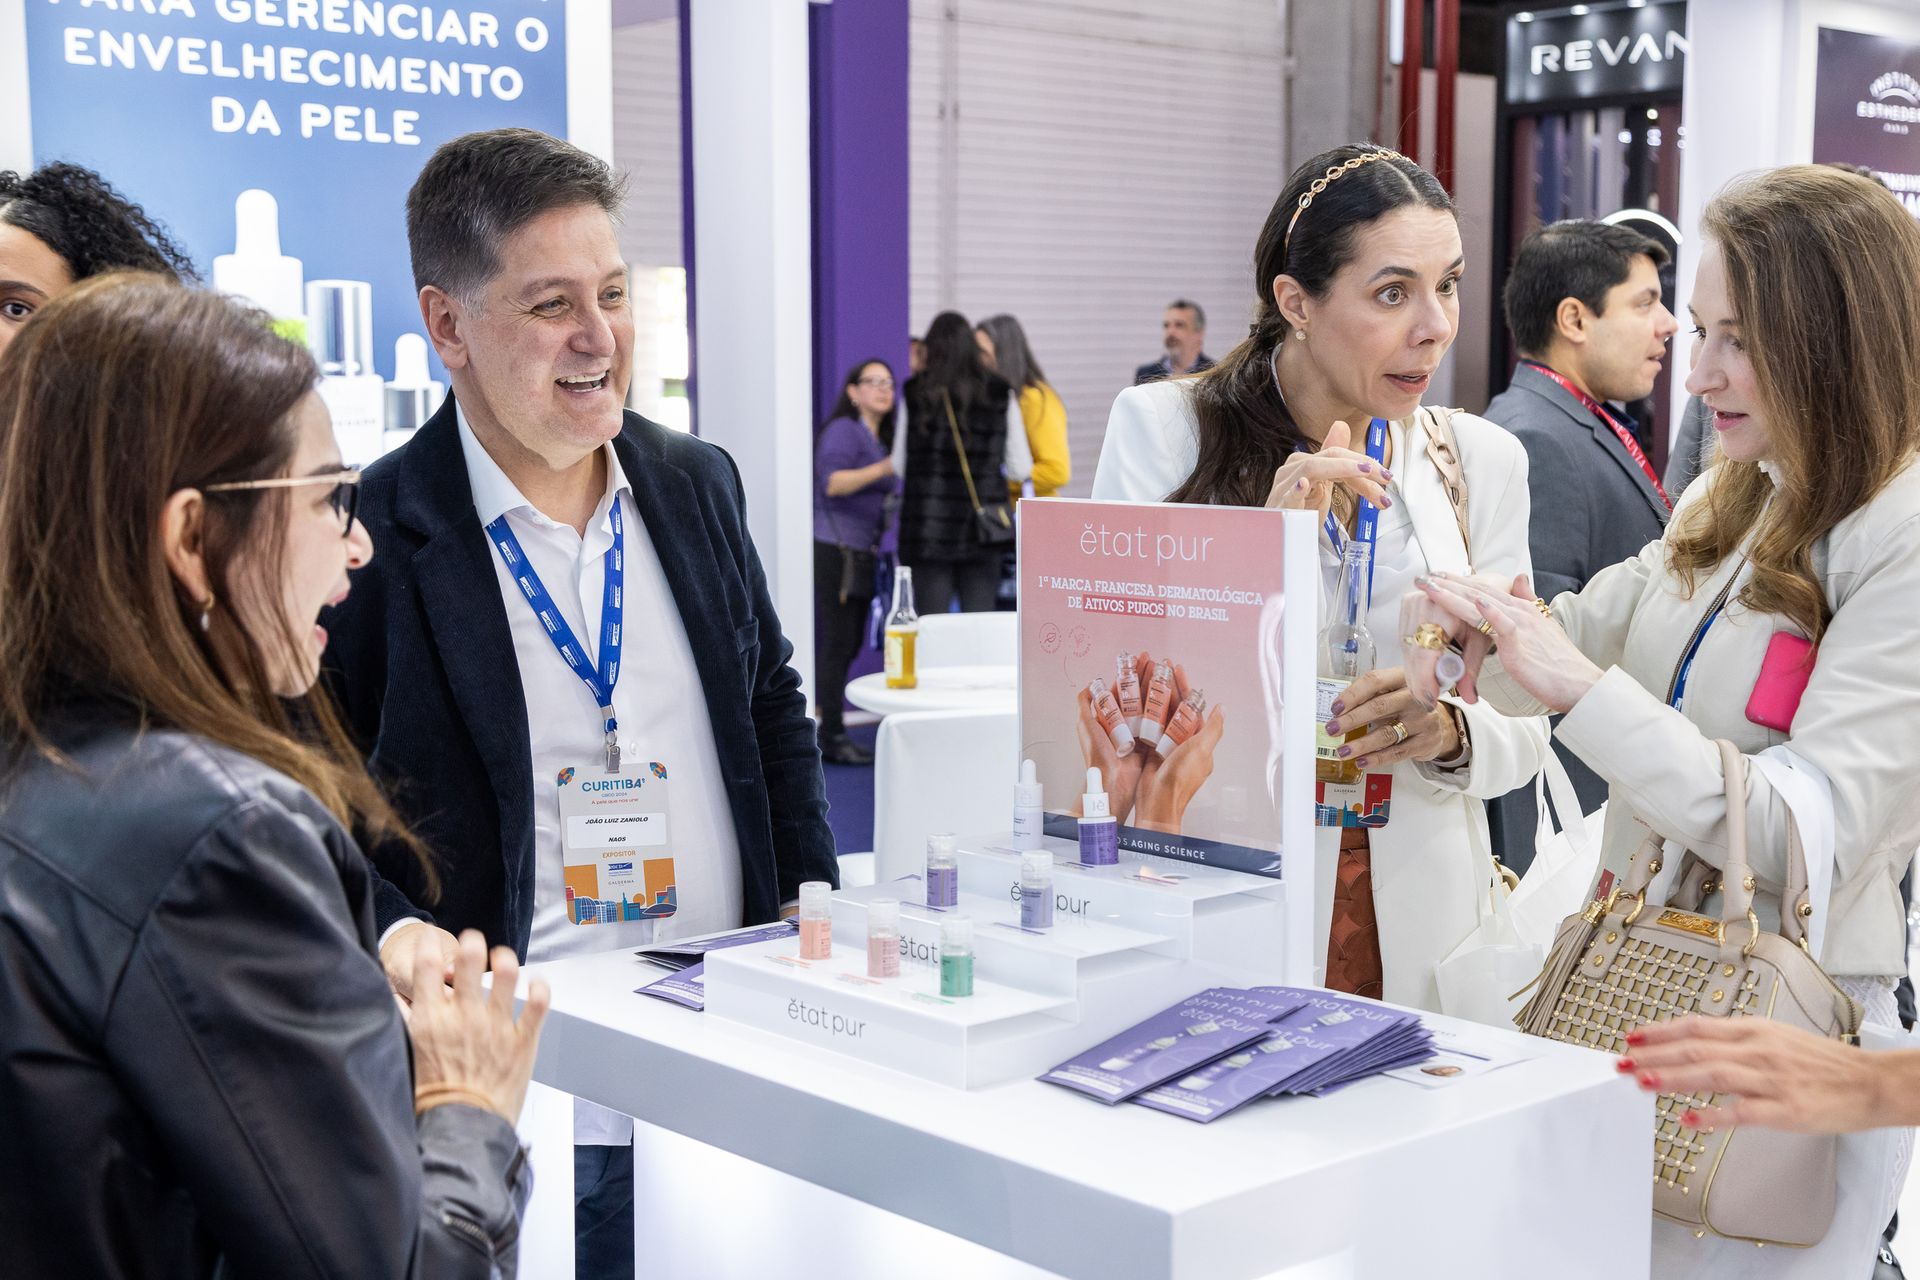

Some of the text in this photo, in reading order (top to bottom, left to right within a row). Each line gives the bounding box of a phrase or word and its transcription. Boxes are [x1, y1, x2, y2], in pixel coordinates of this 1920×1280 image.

[215, 0, 499, 48] GERENCIAR
[515, 17, 549, 52] O
[64, 27, 524, 101] ENVELHECIMENTO
[211, 96, 421, 145] DA PELE
[1156, 533, 1215, 567] pur
[1051, 577, 1093, 592] MARCA
[1094, 580, 1155, 597] FRANCESA
[1158, 585, 1264, 606] DERMATOLÓGICA
[1067, 596, 1230, 622] DE ATIVOS PUROS NO BRASIL
[582, 778, 641, 792] CURITIBA
[585, 816, 604, 824] JOÃO
[602, 850, 636, 859] EXPOSITOR
[1131, 839, 1160, 852] AGING
[1164, 845, 1206, 860] SCIENCE
[1056, 893, 1091, 916] pur
[832, 1013, 867, 1038] pur
